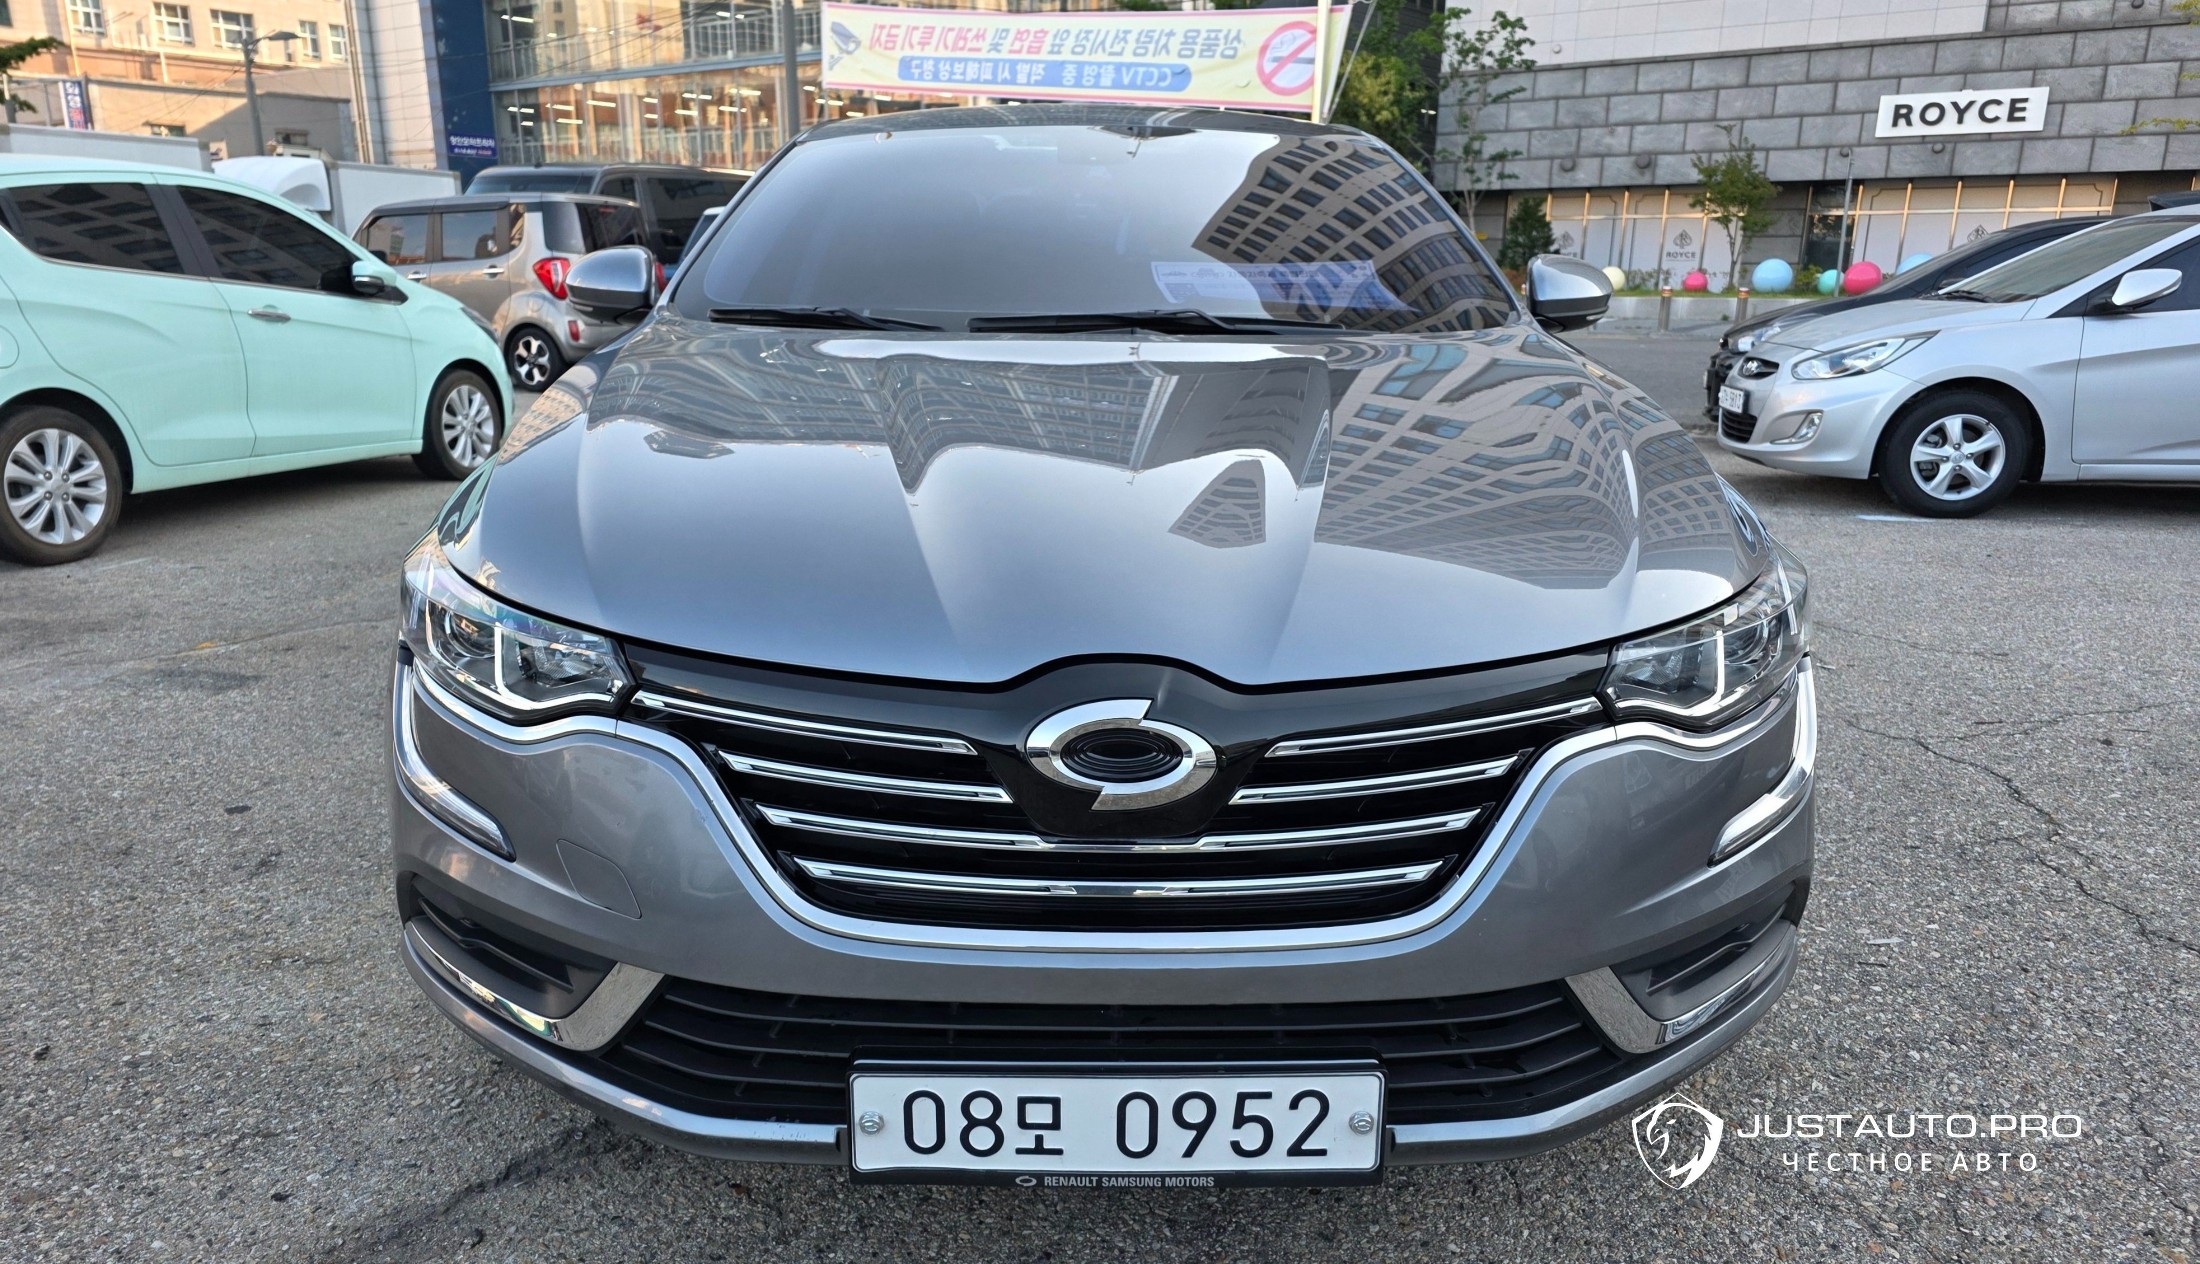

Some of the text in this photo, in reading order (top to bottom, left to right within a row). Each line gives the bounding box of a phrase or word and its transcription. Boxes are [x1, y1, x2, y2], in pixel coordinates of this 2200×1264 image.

[1891, 97, 2030, 128] ROYCE
[1665, 251, 1697, 259] ROYCE
[903, 1089, 1329, 1159] 08모 0952
[1044, 1176, 1215, 1188] RENAULT SAMSUNG MOTORS
